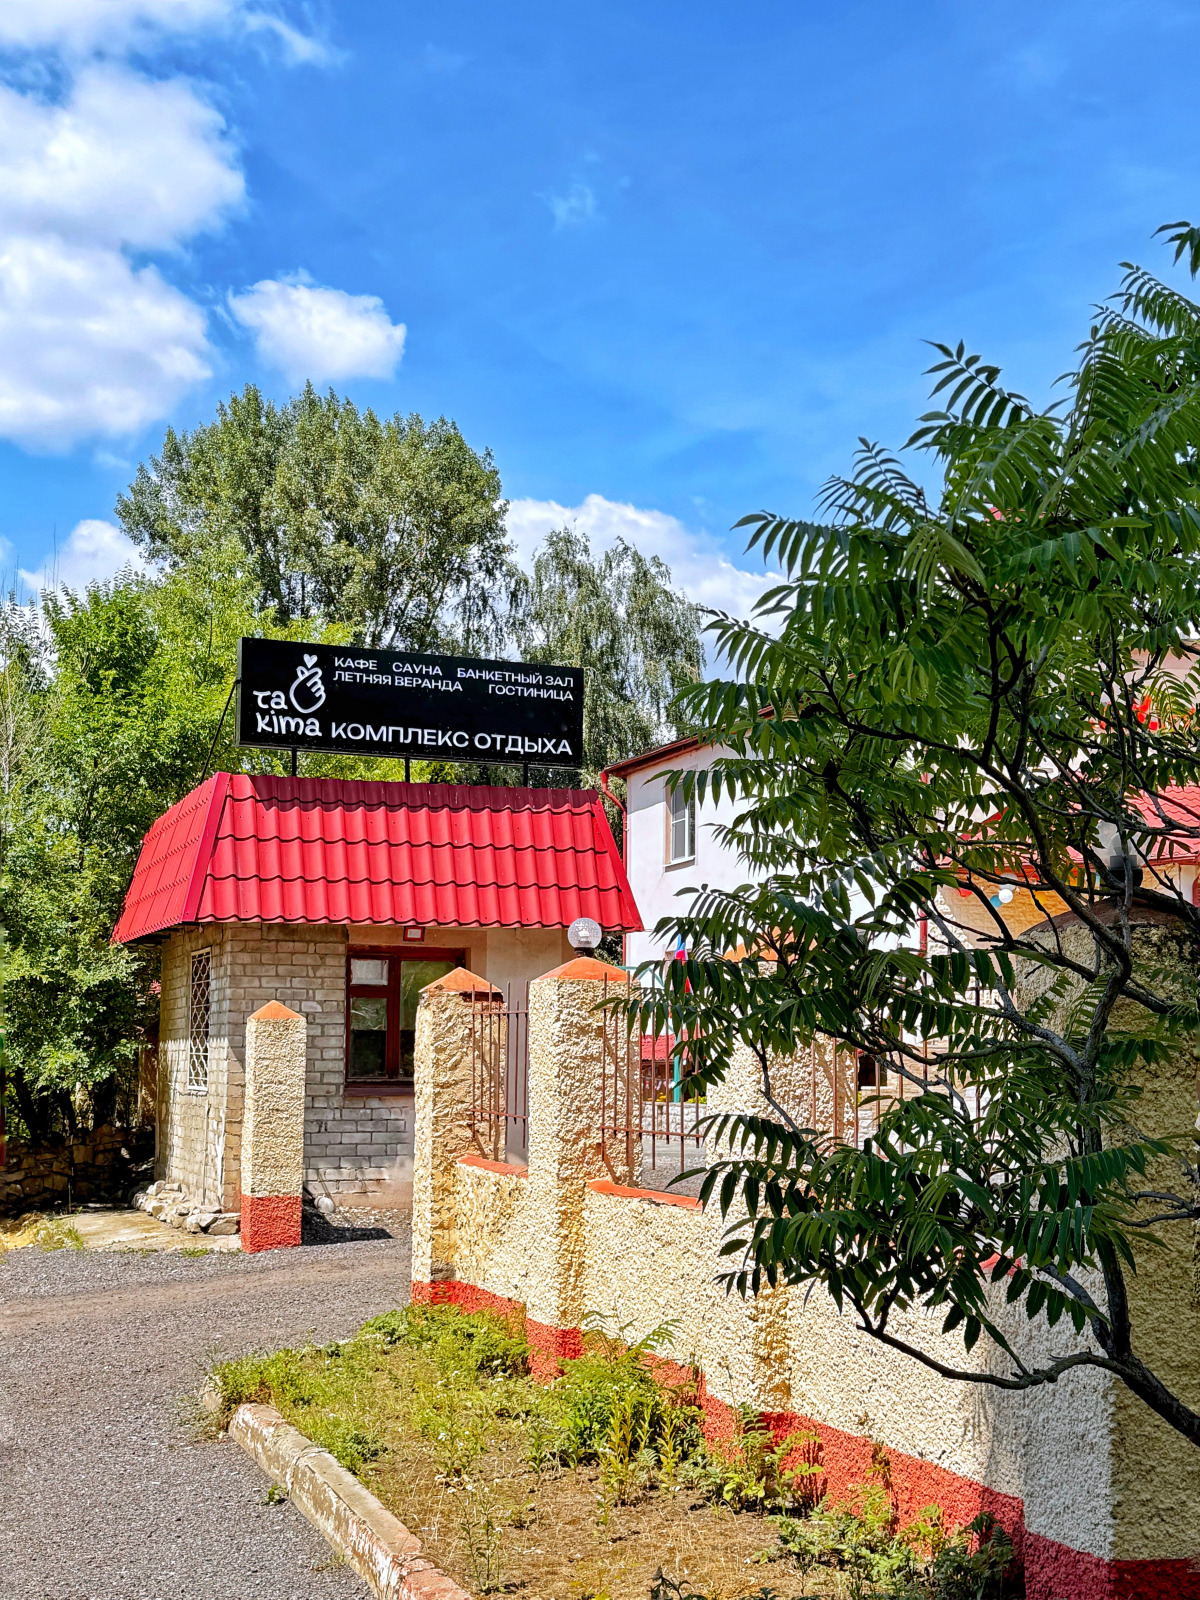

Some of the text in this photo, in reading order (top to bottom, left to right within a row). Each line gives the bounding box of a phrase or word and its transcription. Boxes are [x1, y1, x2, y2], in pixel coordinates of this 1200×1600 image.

[333, 670, 573, 701] ЛЕТНЯЯ ВЕРАНДА ГОСТИНИЦА
[334, 657, 574, 688] КАФЕ САУНА БАНКЕТНЫЙ ЗАЛ
[256, 710, 322, 737] kima
[331, 722, 572, 755] КОМПЛЕКС ОТДЫХА
